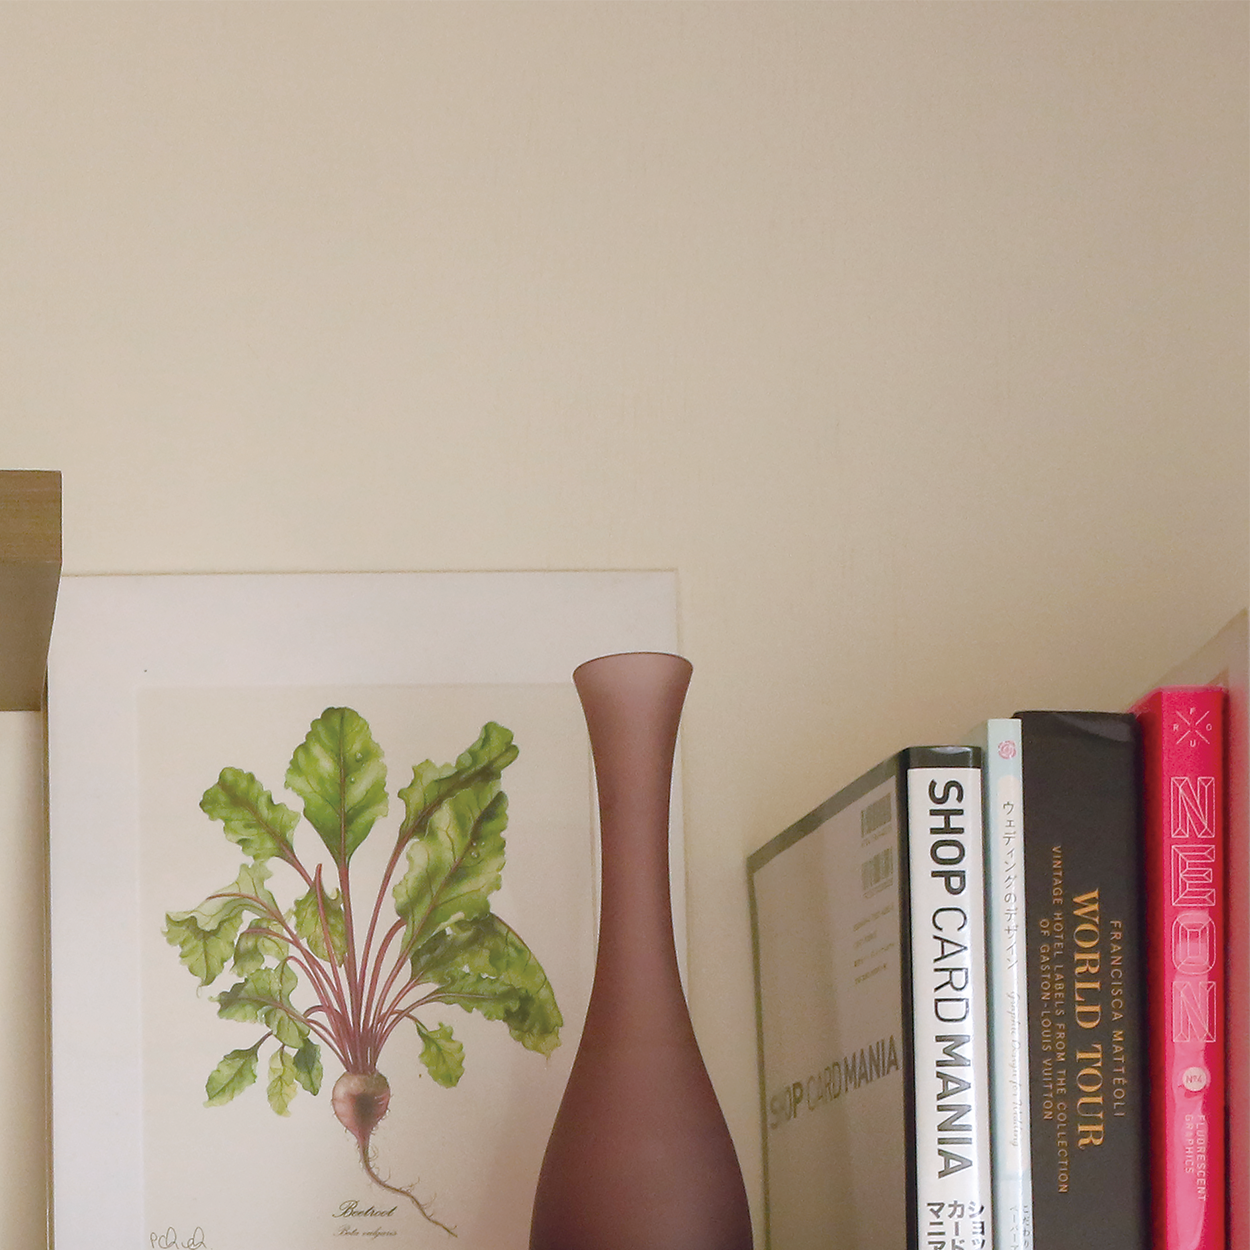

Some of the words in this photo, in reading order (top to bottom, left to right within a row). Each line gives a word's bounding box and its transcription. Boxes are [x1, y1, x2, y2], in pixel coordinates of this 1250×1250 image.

[928, 779, 966, 896] SHOP
[1052, 844, 1064, 905] VINTAGE
[1002, 800, 1019, 970] ウェディングのデザイン
[1039, 918, 1049, 937] OF
[1170, 776, 1217, 1043] NEON
[931, 907, 970, 1023] CARD
[1053, 911, 1065, 957] HOTEL
[1072, 887, 1102, 1030] WORLD
[1110, 919, 1125, 1021] FRANCISCA
[1040, 944, 1052, 1052] GASTON-LOUIS
[1054, 964, 1065, 1017] LABELS
[843, 1035, 900, 1092] MANIA
[1055, 1022, 1066, 1062] FROM
[1057, 1069, 1067, 1095] THE
[1112, 1029, 1126, 1117] MATTÉOLI
[934, 1034, 973, 1179] MANIA
[1042, 1058, 1053, 1121] VUITTON
[1076, 1042, 1105, 1150] TOUR
[1057, 1102, 1069, 1194] COLLECTION
[1184, 1113, 1194, 1174] GRAPHICS
[1196, 1113, 1209, 1202] FLUORESCENT
[332, 1200, 399, 1218] Beetroot
